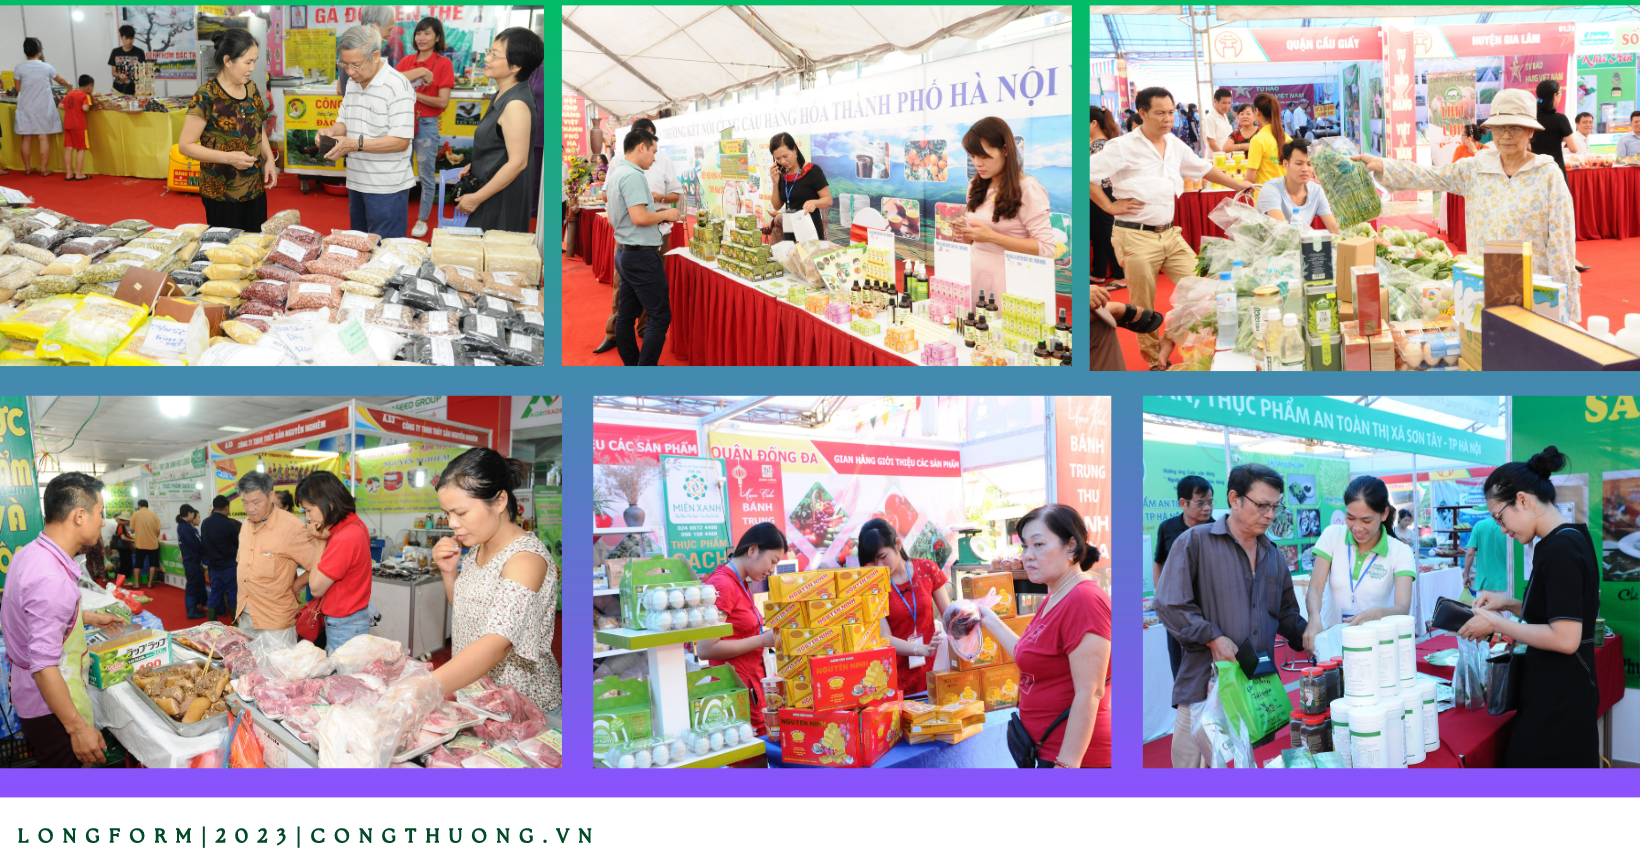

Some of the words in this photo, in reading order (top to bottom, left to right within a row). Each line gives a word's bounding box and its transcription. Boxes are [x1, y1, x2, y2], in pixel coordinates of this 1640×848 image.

[315, 6, 338, 24] GÀ
[1338, 36, 1360, 49] GIẤY
[1472, 33, 1502, 47] HUYỆN
[1504, 34, 1519, 44] GIA
[1521, 32, 1540, 44] LÂM
[1622, 27, 1640, 46] SỐ
[800, 100, 829, 125] HÓA
[832, 92, 891, 120] THÀNH
[897, 79, 943, 113] PHỐ
[949, 72, 988, 108] HÀ
[997, 66, 1059, 106] NỘI
[1440, 105, 1466, 119] THỊT
[382, 414, 395, 424] A.53
[1260, 397, 1310, 425] PHẨM
[1314, 410, 1334, 429] AN
[1336, 414, 1370, 436] TOÀN
[1372, 422, 1389, 442] THỊ
[1391, 424, 1405, 442] XÃ
[1407, 429, 1425, 445] SƠN
[1426, 431, 1442, 448] TÂY
[1448, 438, 1458, 450] TP
[1459, 438, 1469, 452] HÀ
[1469, 443, 1482, 456] NỘI
[224, 441, 233, 449] A.53
[609, 438, 633, 451] CÁC
[637, 439, 661, 453] SẢN
[1070, 433, 1104, 454] BÁNH
[800, 452, 818, 465] ĐA
[834, 454, 854, 464] GIAN
[856, 453, 876, 465] HÀNG
[877, 456, 895, 466] GIỚI
[895, 457, 915, 469] THIỆU
[916, 457, 929, 468] CÁC
[930, 458, 942, 468] SẢN
[1069, 463, 1106, 478] TRUNG
[1077, 489, 1099, 503] THU
[1158, 499, 1169, 507] AN
[697, 504, 722, 512] XANH
[742, 502, 773, 512] BÁNH
[1145, 512, 1155, 521] TP
[1157, 511, 1168, 520] HÀ
[671, 540, 697, 549] THỰC
[816, 663, 848, 675] NGUYÊN
[850, 661, 869, 670] NINH
[781, 718, 809, 727] NGUYÊN
